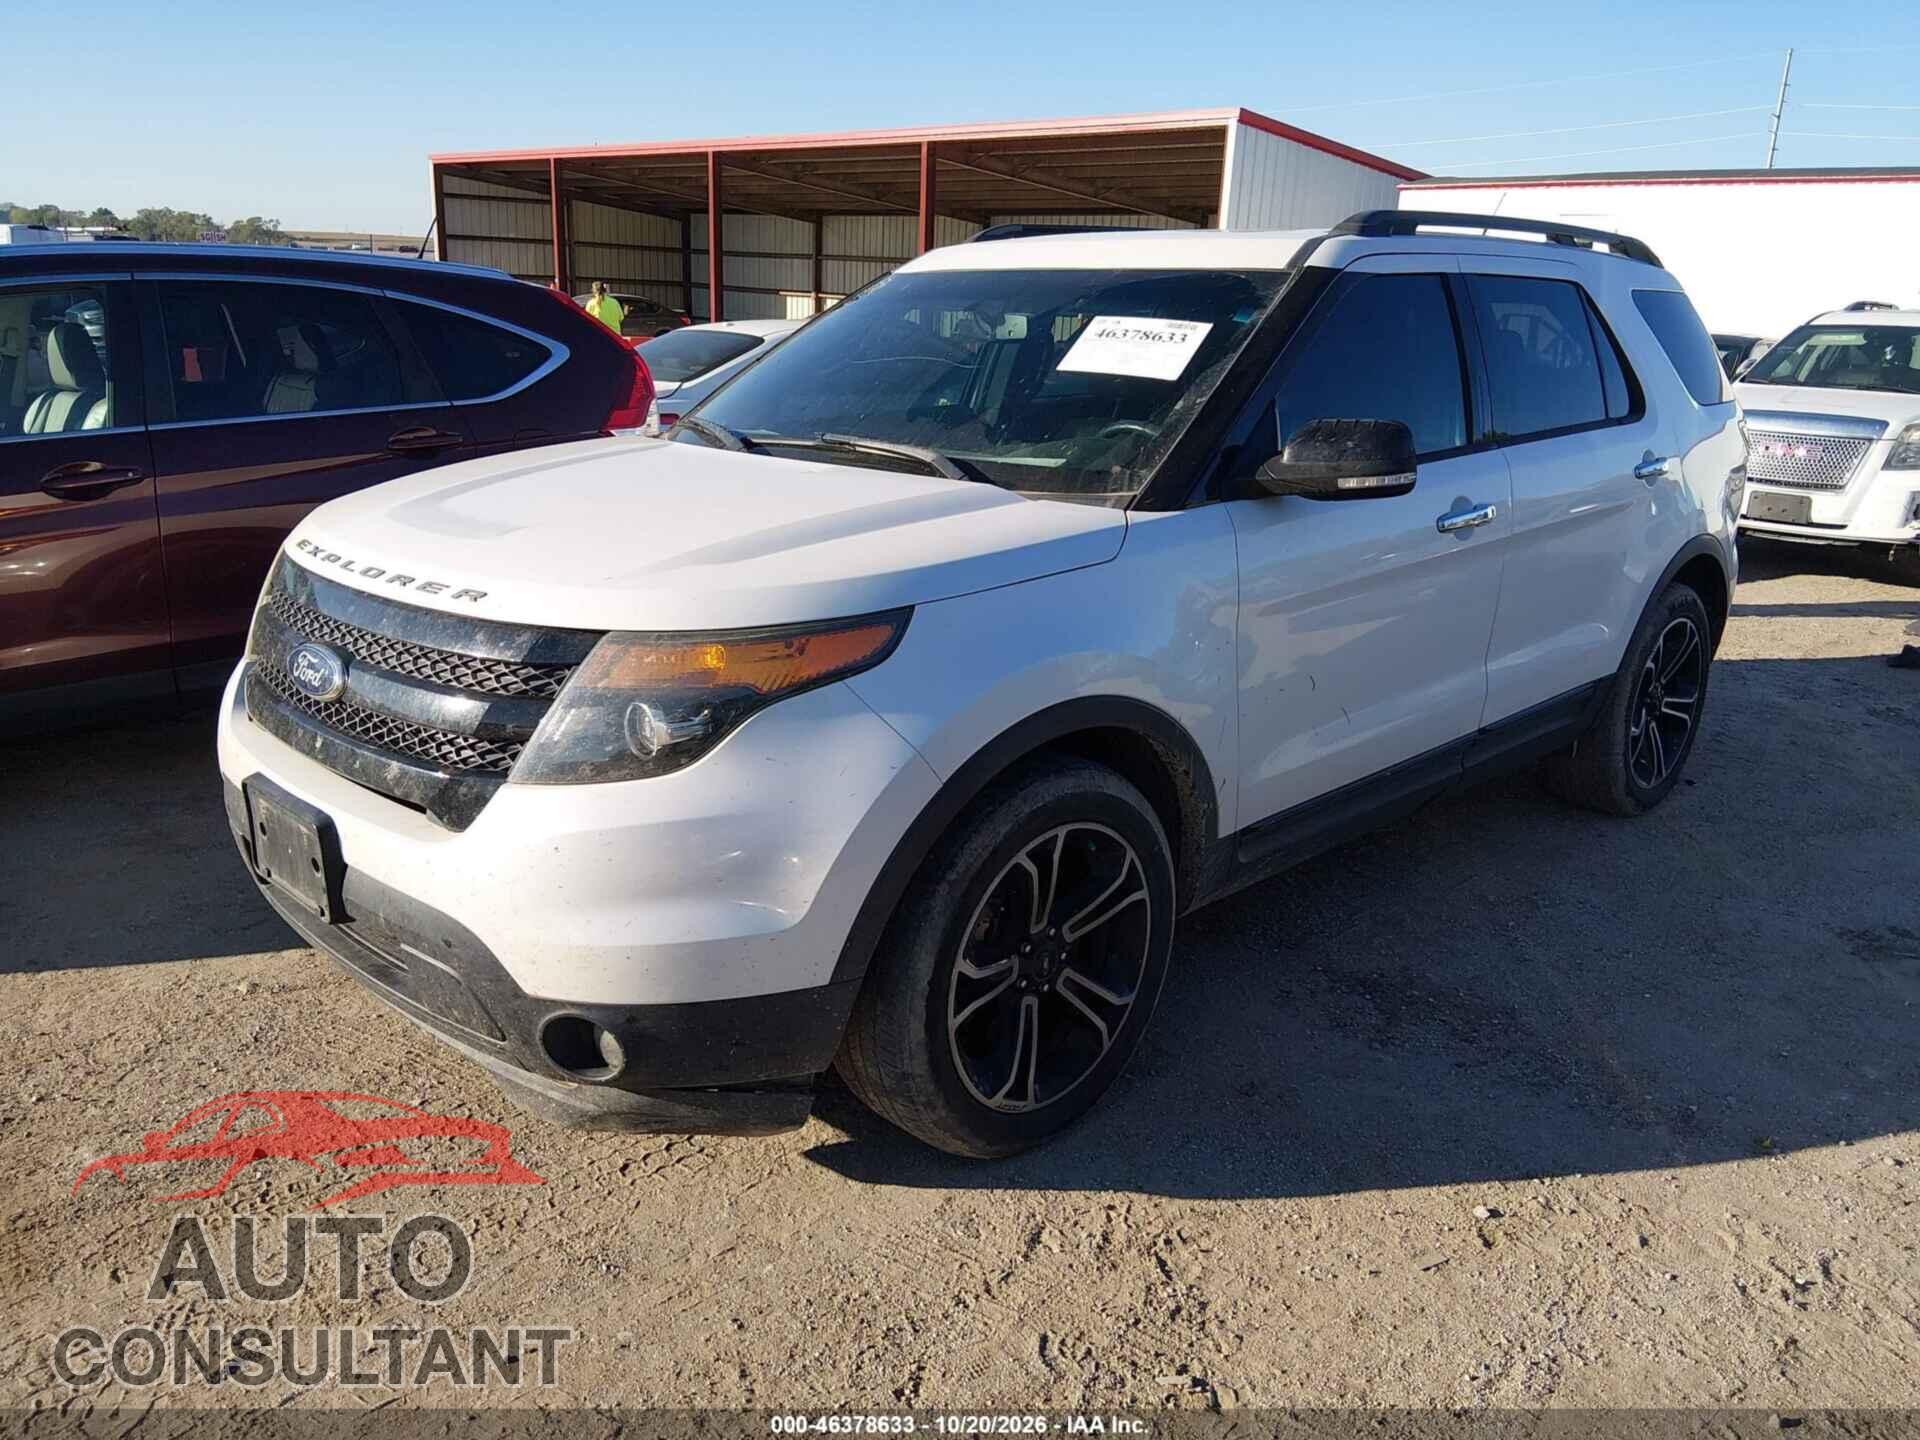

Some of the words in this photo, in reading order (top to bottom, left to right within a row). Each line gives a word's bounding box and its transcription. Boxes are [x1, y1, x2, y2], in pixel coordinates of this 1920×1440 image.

[1096, 328, 1188, 343] 46378633
[296, 538, 488, 602] EXPLORER
[293, 651, 326, 687] Ford
